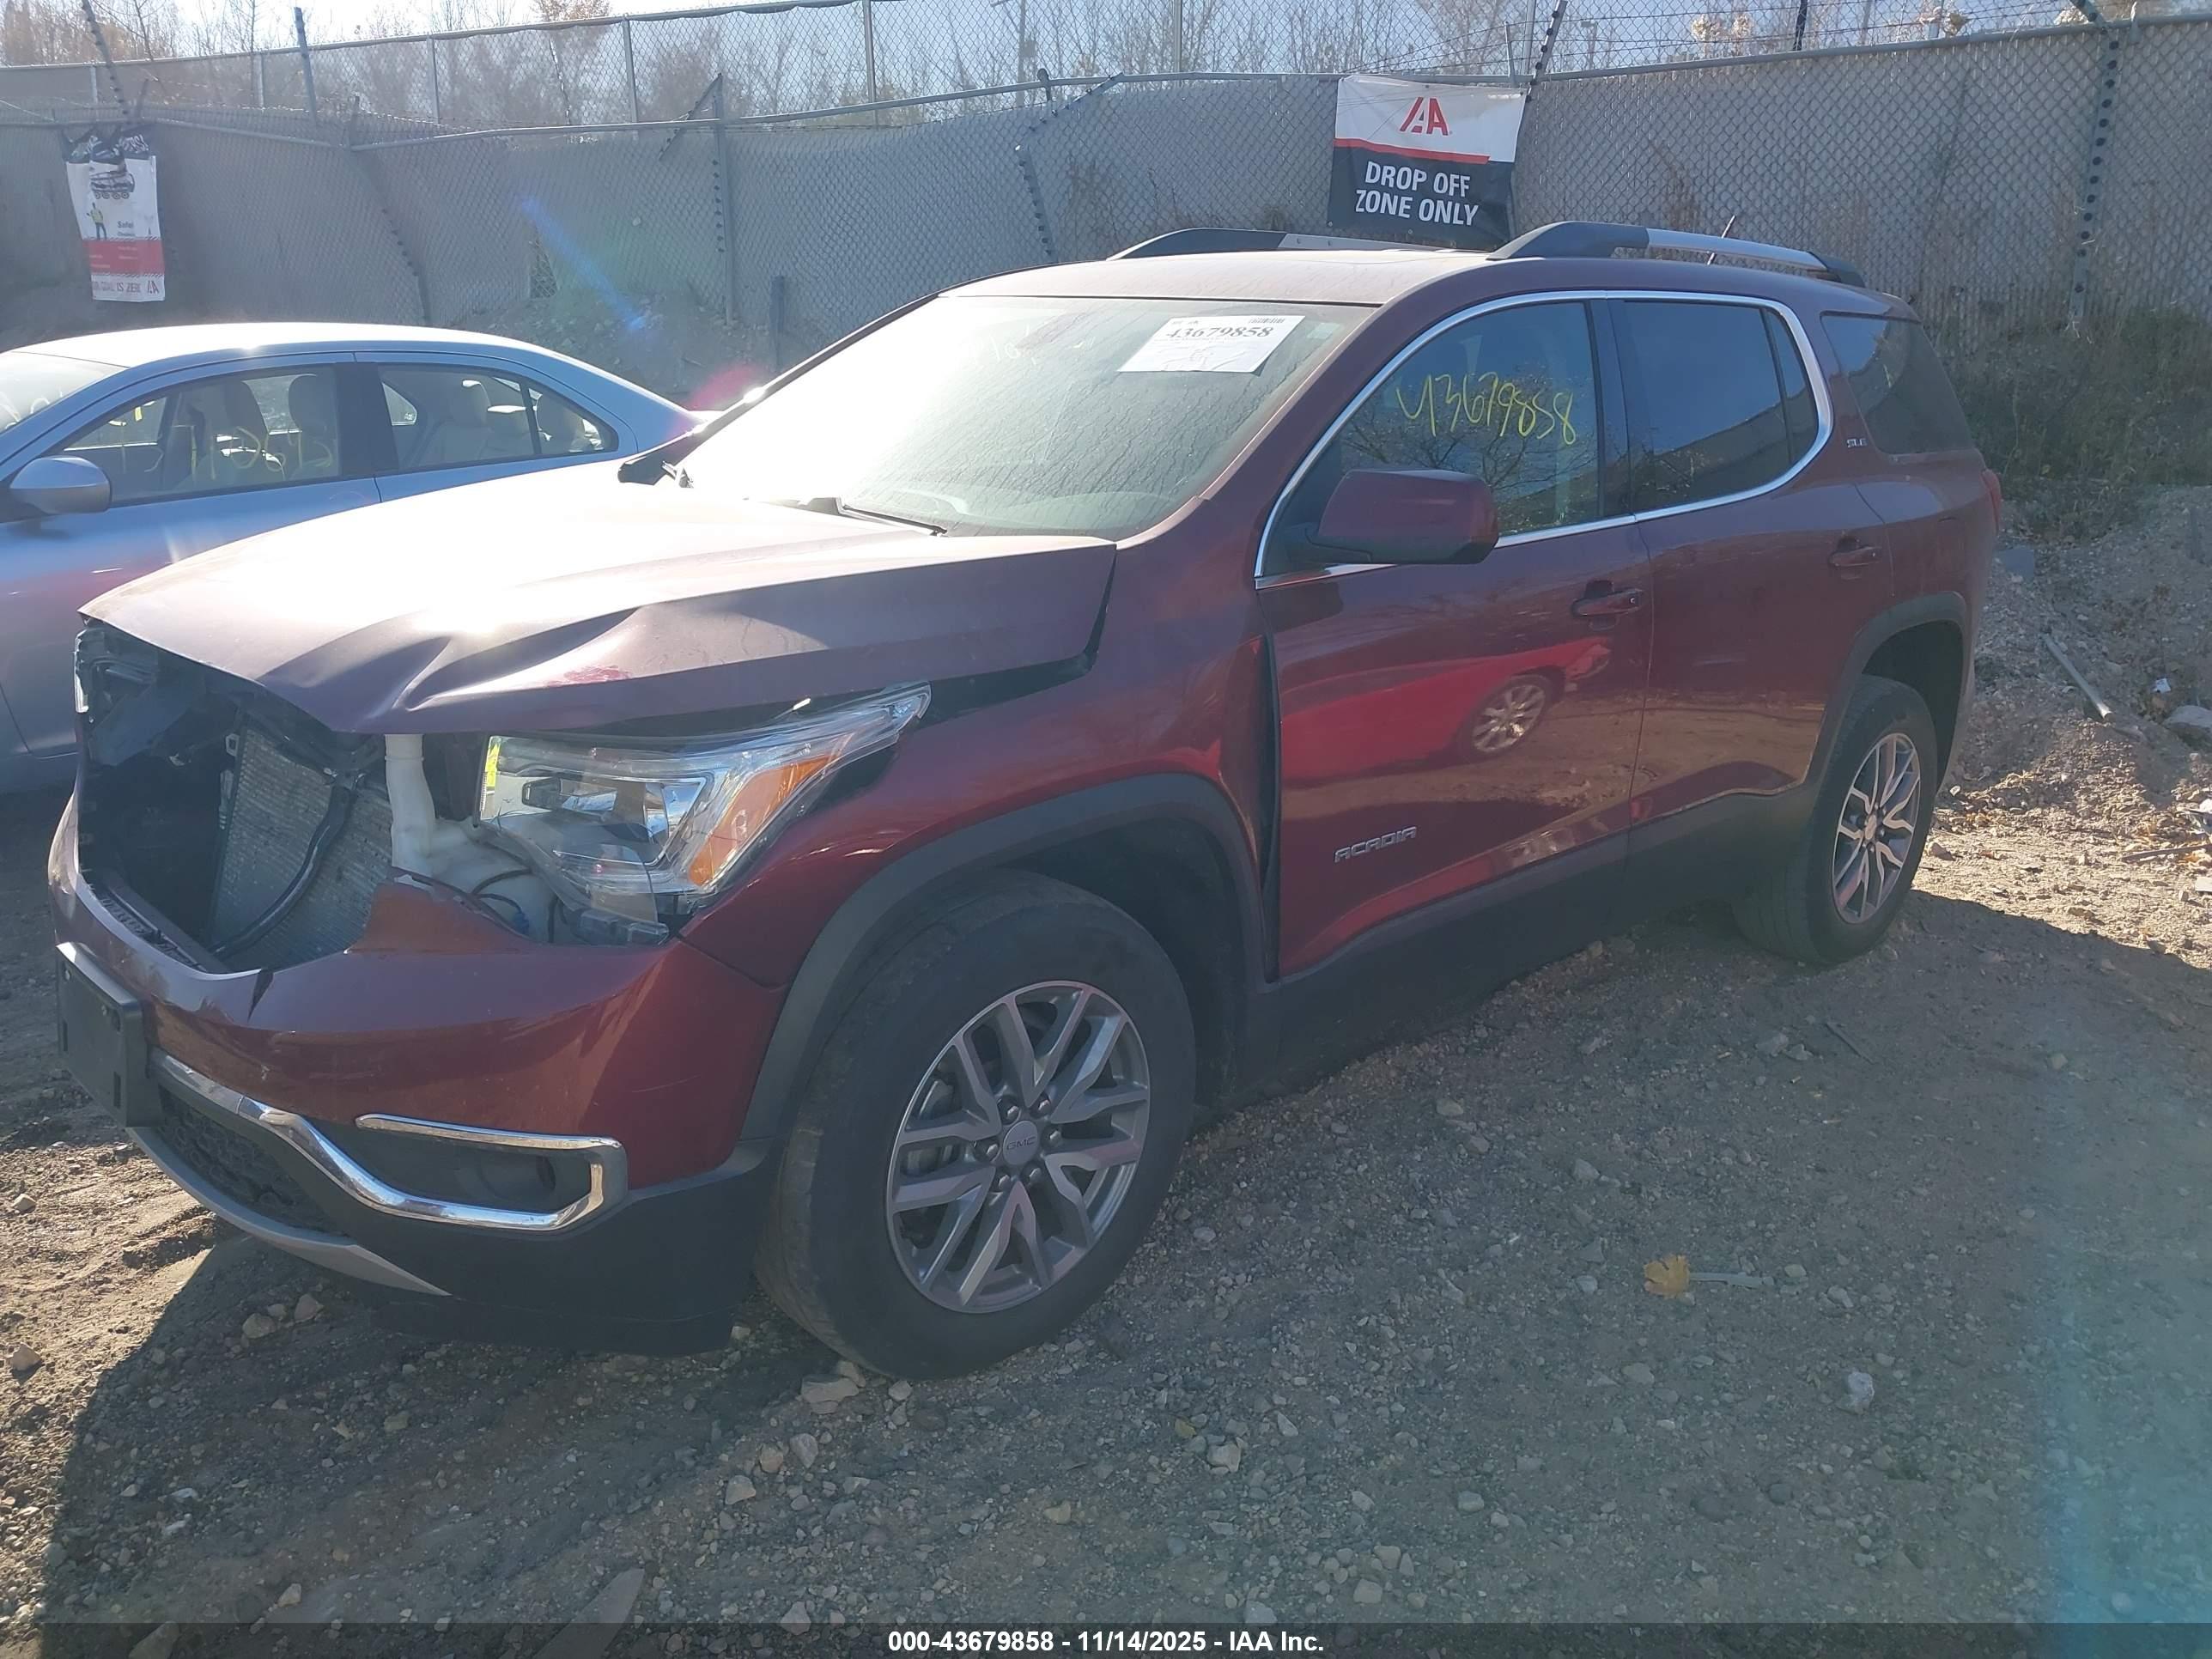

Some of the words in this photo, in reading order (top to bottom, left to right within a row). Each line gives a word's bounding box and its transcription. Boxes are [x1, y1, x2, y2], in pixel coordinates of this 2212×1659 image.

[1365, 161, 1427, 191] DROP
[1433, 173, 1471, 198] OFF
[1355, 189, 1413, 218] ZONE
[1419, 198, 1479, 226] ONLY
[1166, 325, 1274, 338] 43679858
[1396, 371, 1577, 445] 43679858
[1334, 826, 1417, 863] ACADIA
[1006, 1136, 1036, 1151] GMC
